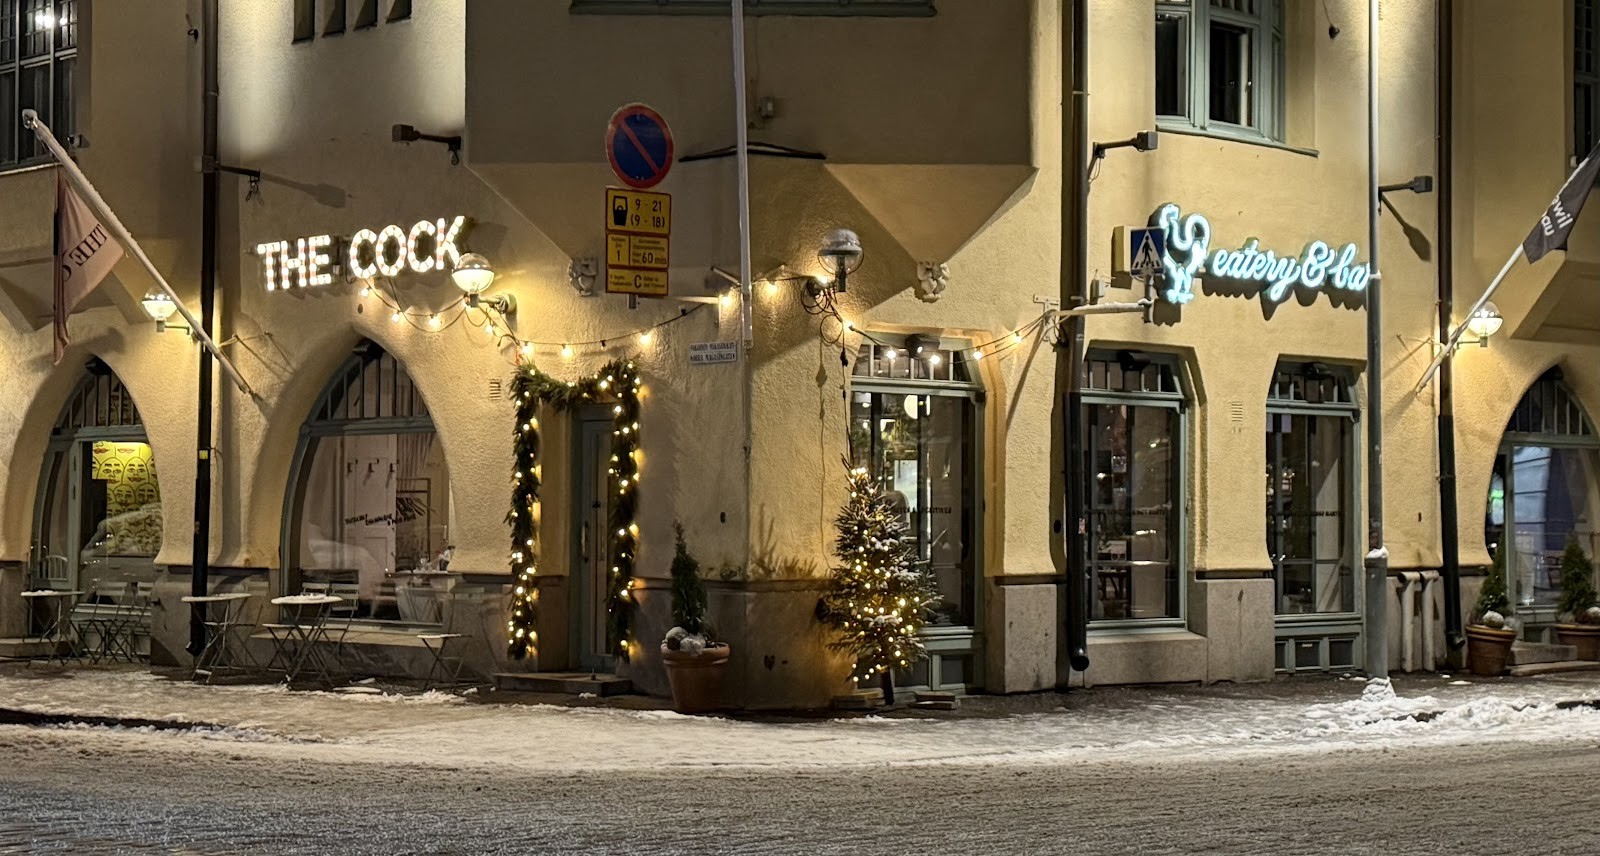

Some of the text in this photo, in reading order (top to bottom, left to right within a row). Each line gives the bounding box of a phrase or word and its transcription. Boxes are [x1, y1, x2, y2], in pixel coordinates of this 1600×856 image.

[635, 198, 641, 211] 9
[652, 200, 662, 213] 21
[630, 213, 641, 227] (9
[652, 215, 665, 228] 18)
[257, 215, 465, 291] THE COCK
[642, 252, 654, 264] 60
[1212, 239, 1370, 301] eatery & ba
[634, 274, 642, 289] C
